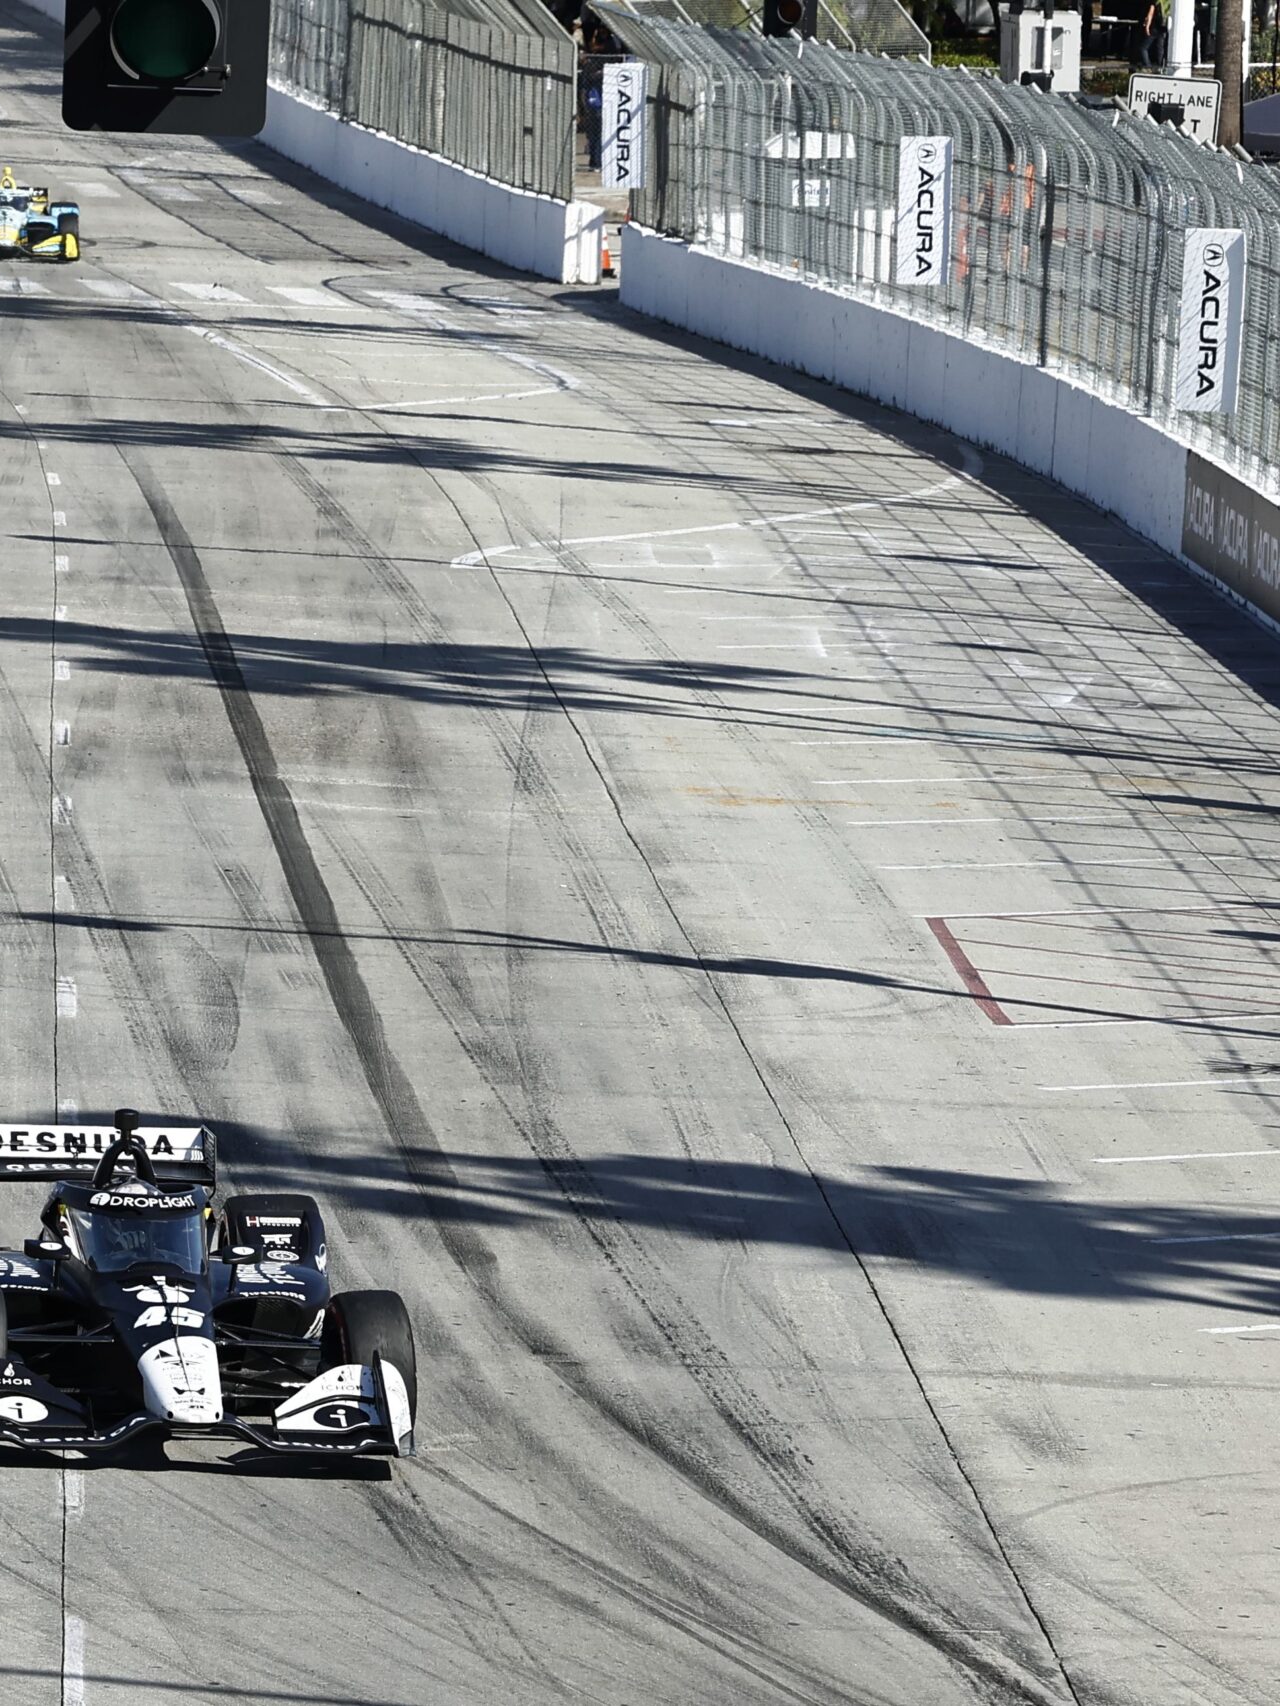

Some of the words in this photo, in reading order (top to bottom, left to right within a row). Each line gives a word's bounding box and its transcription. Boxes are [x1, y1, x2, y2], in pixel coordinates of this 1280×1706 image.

[1135, 90, 1173, 105] RIGHT
[1179, 94, 1213, 108] LANE
[616, 89, 631, 182] ACURA
[915, 166, 934, 277] ACURA
[1196, 269, 1221, 398] ACURA
[1189, 484, 1215, 545] ACURA
[1222, 505, 1249, 569] ACURA
[1256, 528, 1280, 591] ACUR
[110, 1194, 196, 1208] DROPLIGHT
[0, 1283, 49, 1292] estone
[133, 1305, 206, 1329] 45
[320, 1384, 364, 1392] ICHOR
